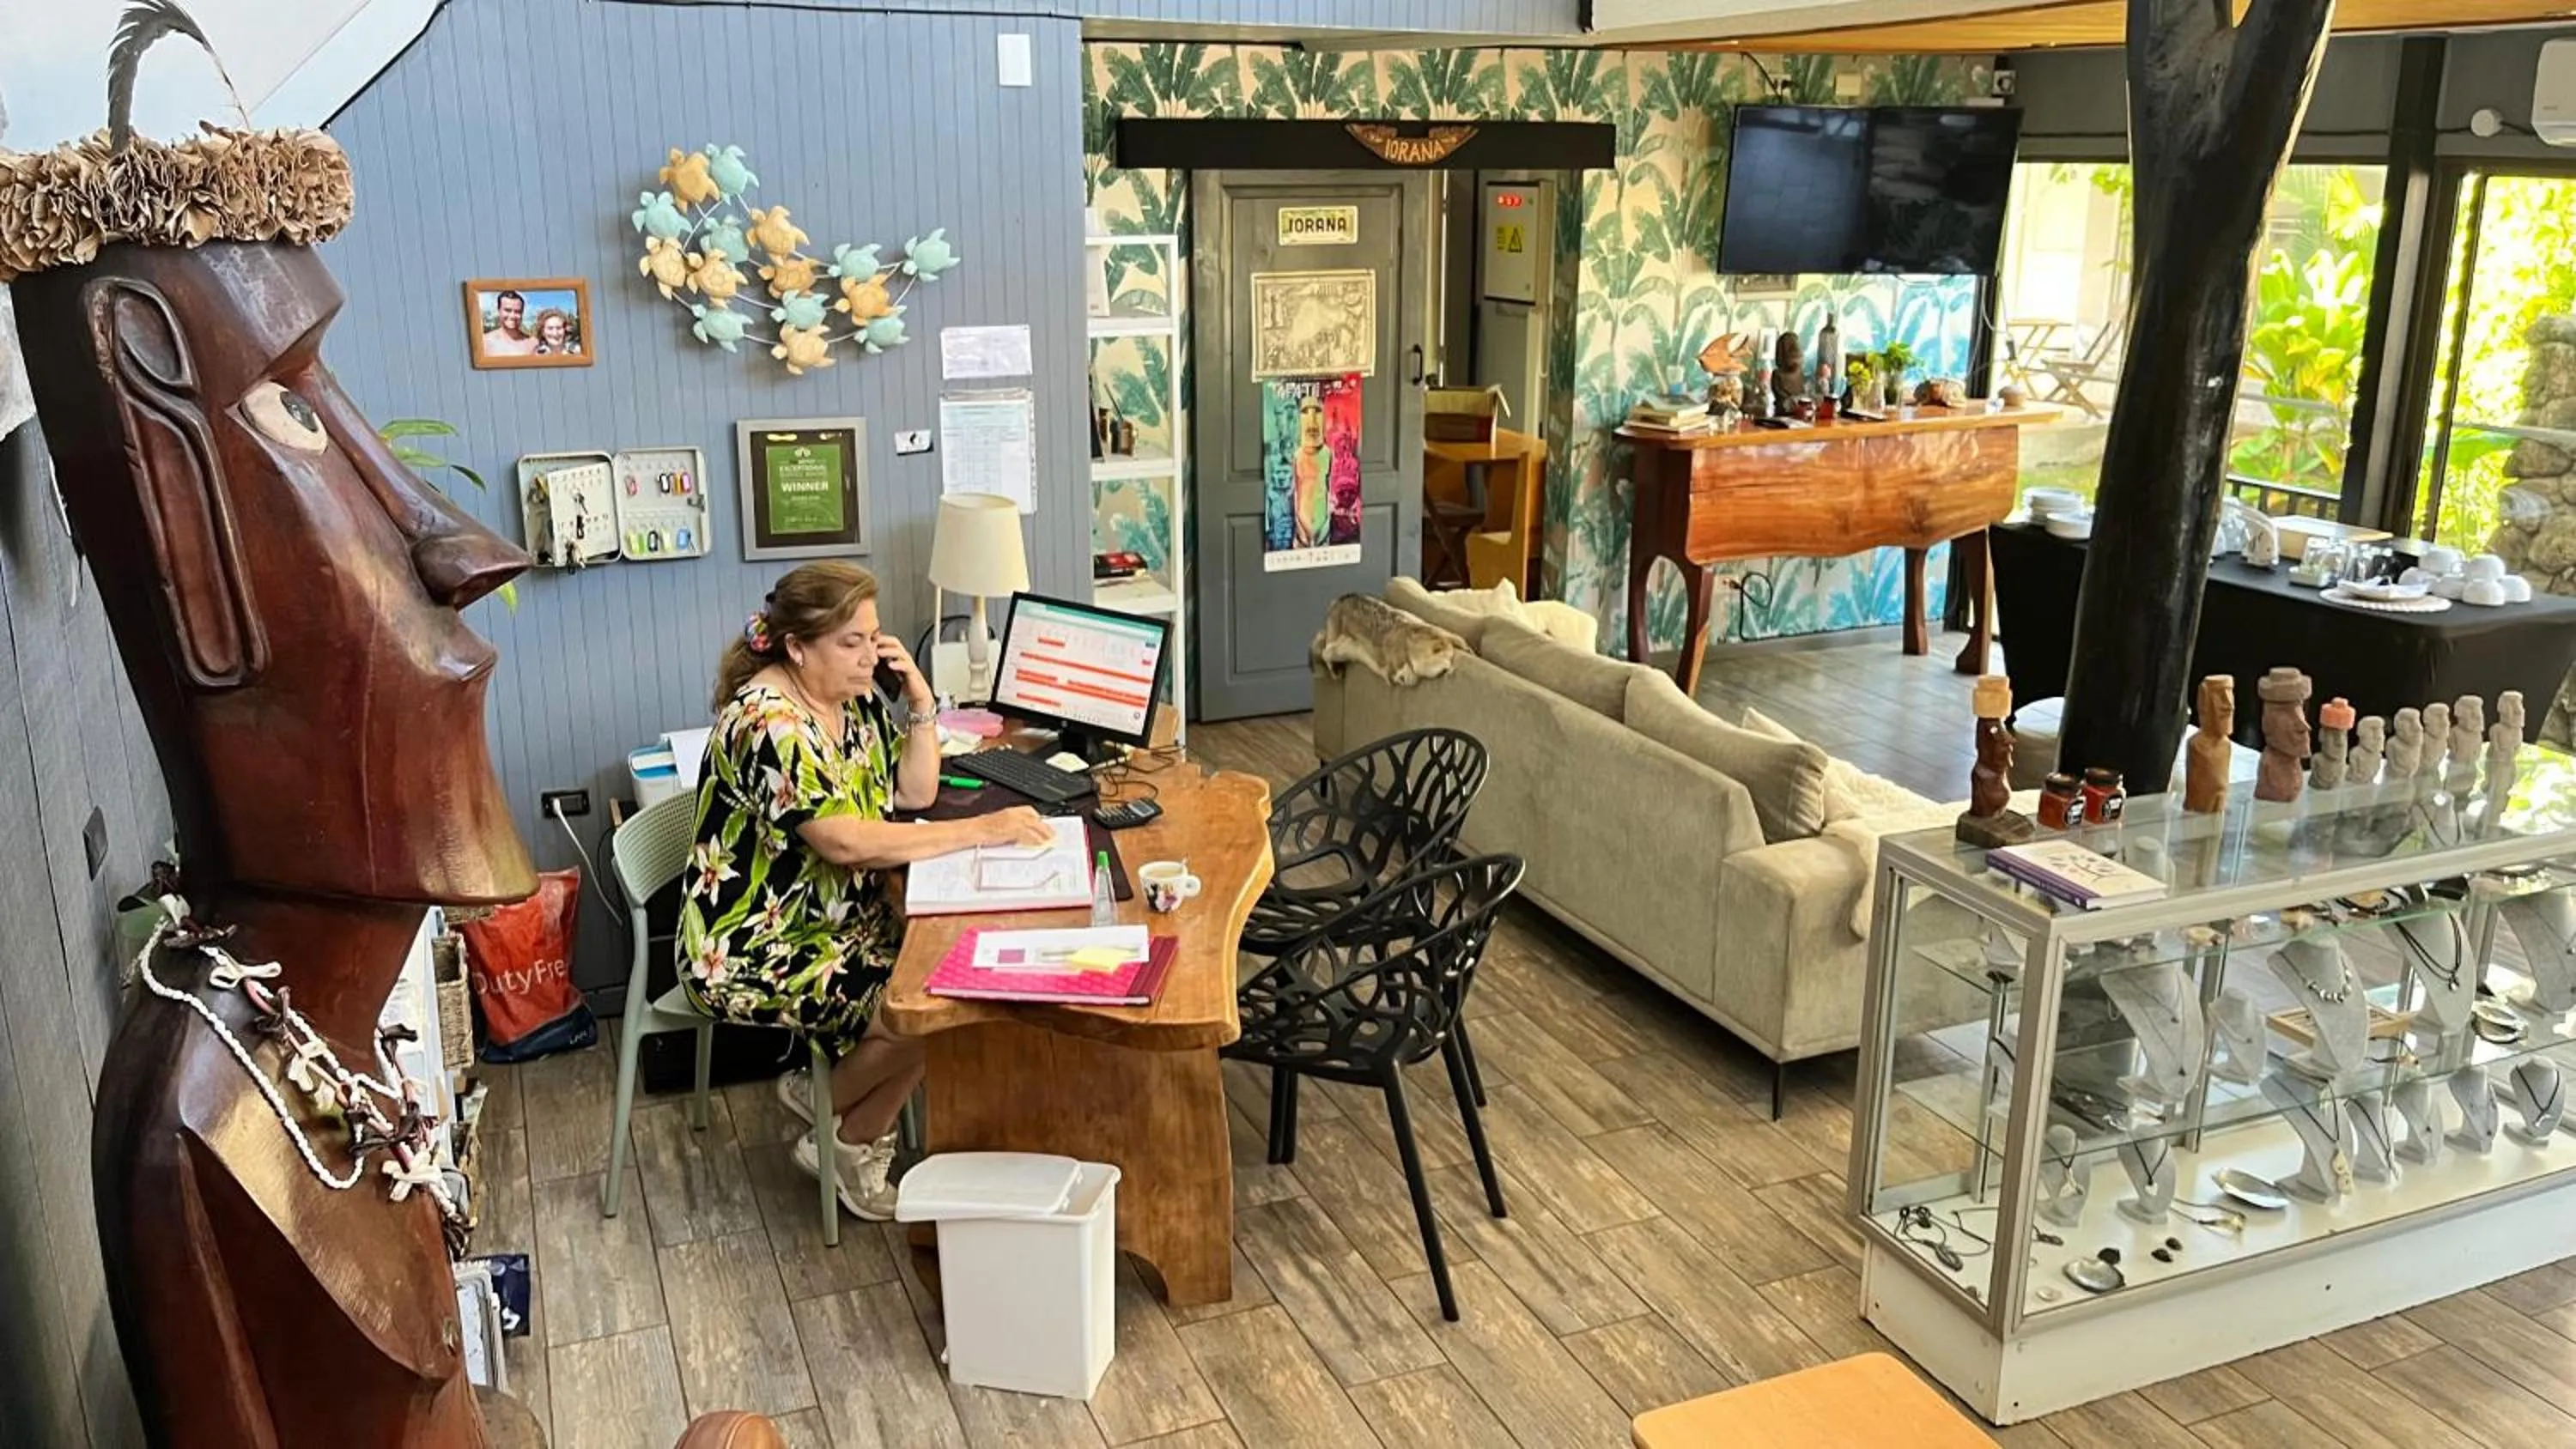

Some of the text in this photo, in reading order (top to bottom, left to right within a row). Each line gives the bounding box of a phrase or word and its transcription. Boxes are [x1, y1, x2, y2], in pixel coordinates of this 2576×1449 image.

[1385, 138, 1445, 162] IORANA
[1288, 217, 1347, 233] IORANA
[781, 481, 829, 492] WINNER
